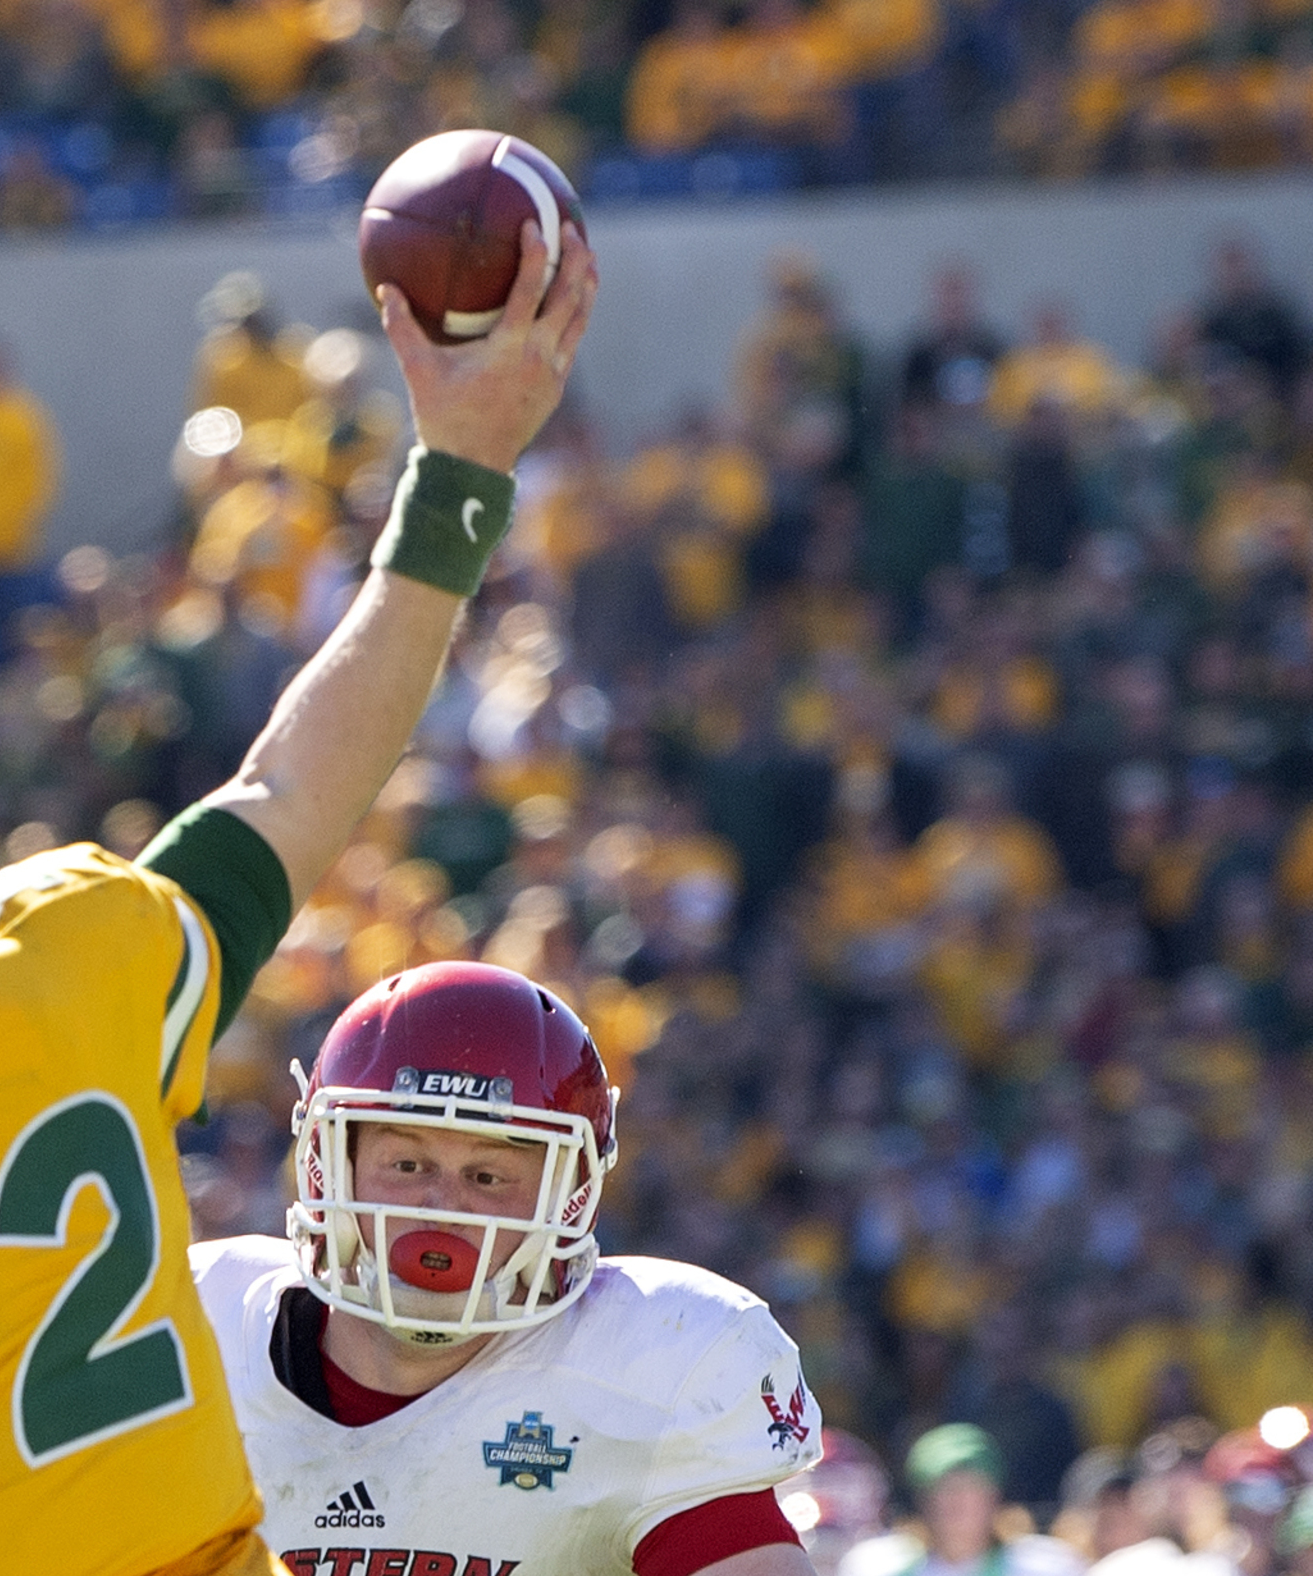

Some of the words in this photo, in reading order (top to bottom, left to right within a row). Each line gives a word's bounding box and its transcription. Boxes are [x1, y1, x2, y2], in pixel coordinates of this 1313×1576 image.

[422, 1073, 487, 1098] EWU
[489, 1449, 567, 1466] CHAMPIONSHIP
[314, 1508, 386, 1529] adidas
